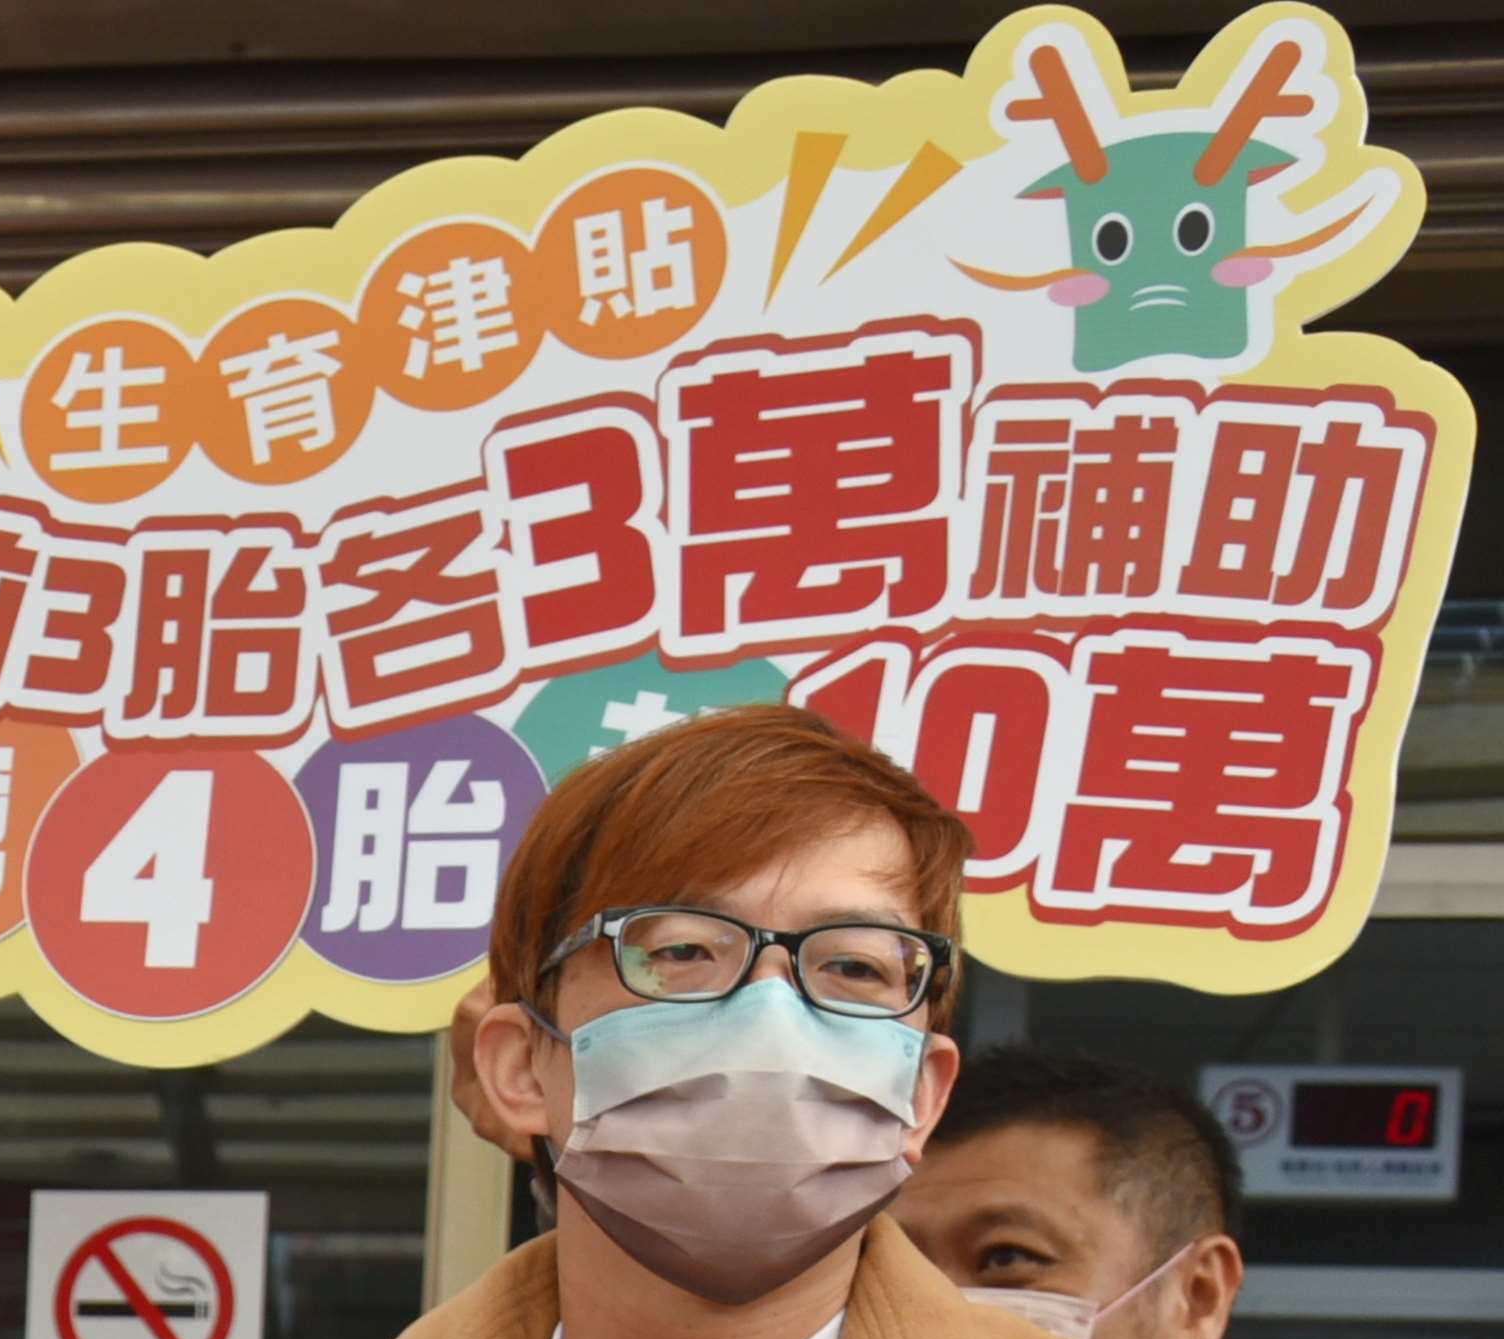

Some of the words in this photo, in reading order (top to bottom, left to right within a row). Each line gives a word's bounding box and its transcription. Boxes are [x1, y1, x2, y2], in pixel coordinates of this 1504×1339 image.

[45, 200, 701, 473] 生育津貼
[1230, 1092, 1265, 1135] 5
[1386, 1088, 1434, 1147] 0
